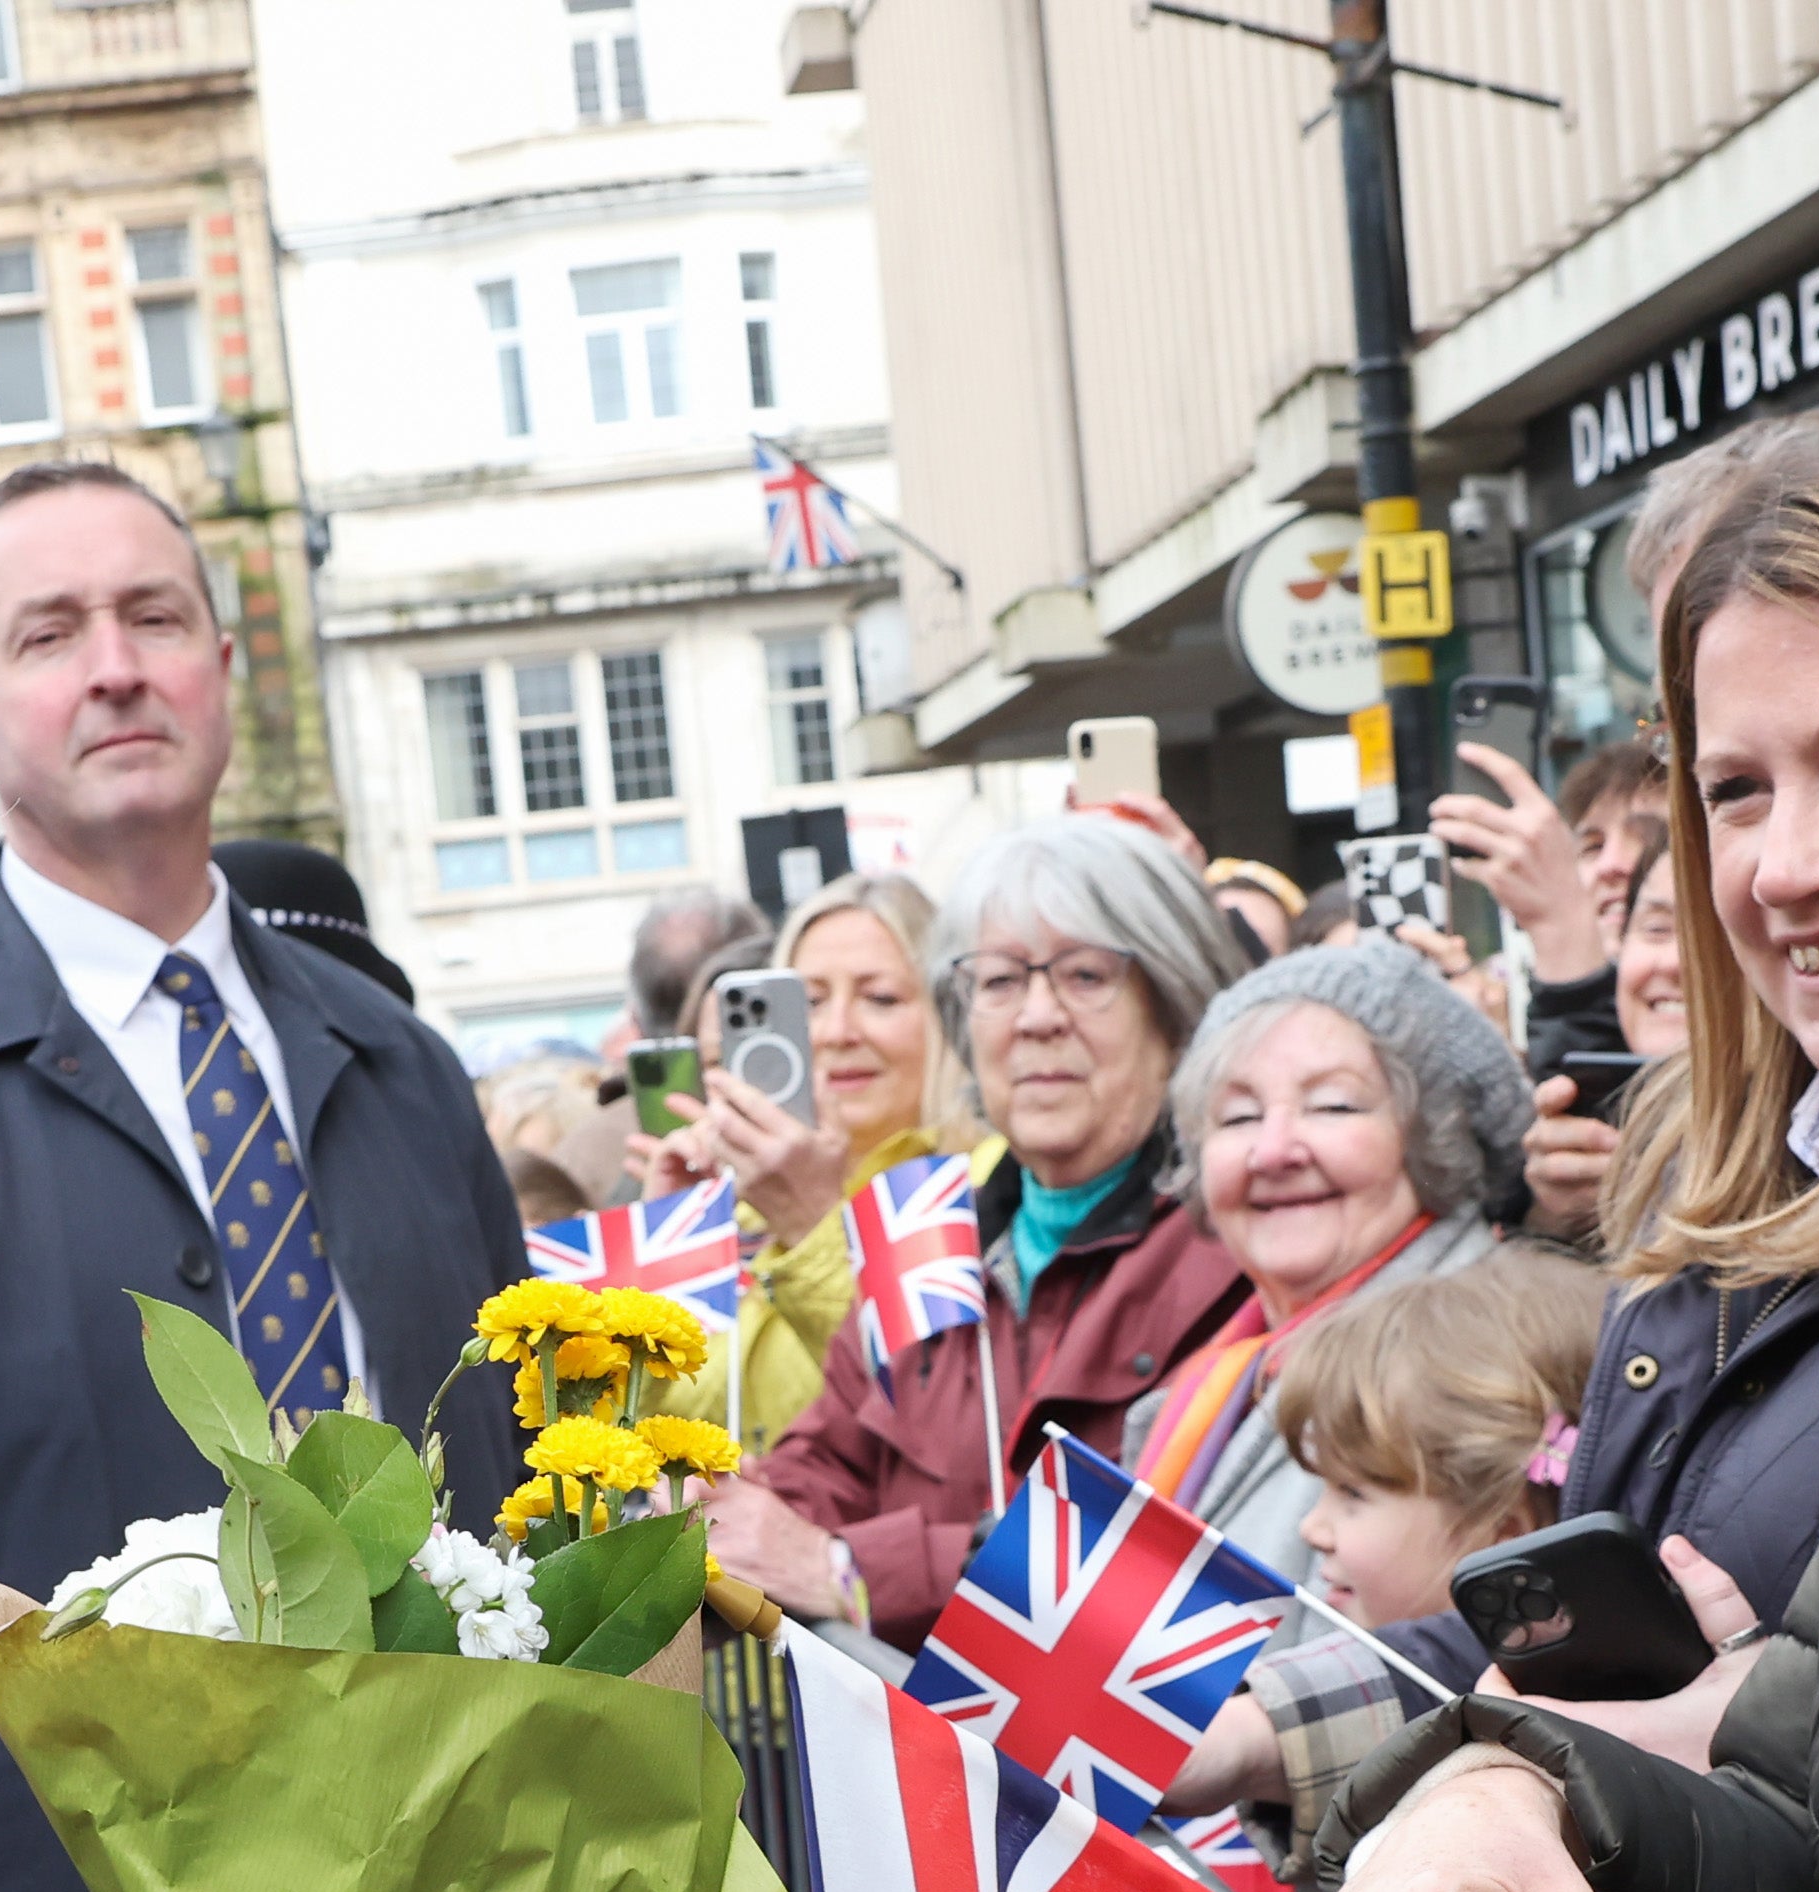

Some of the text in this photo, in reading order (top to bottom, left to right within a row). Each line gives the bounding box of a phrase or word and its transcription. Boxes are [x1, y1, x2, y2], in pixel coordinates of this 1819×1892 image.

[1569, 336, 1706, 488] DAILY
[1375, 546, 1434, 622] H
[1288, 613, 1362, 643] DAIL
[1284, 642, 1379, 672] BREW
